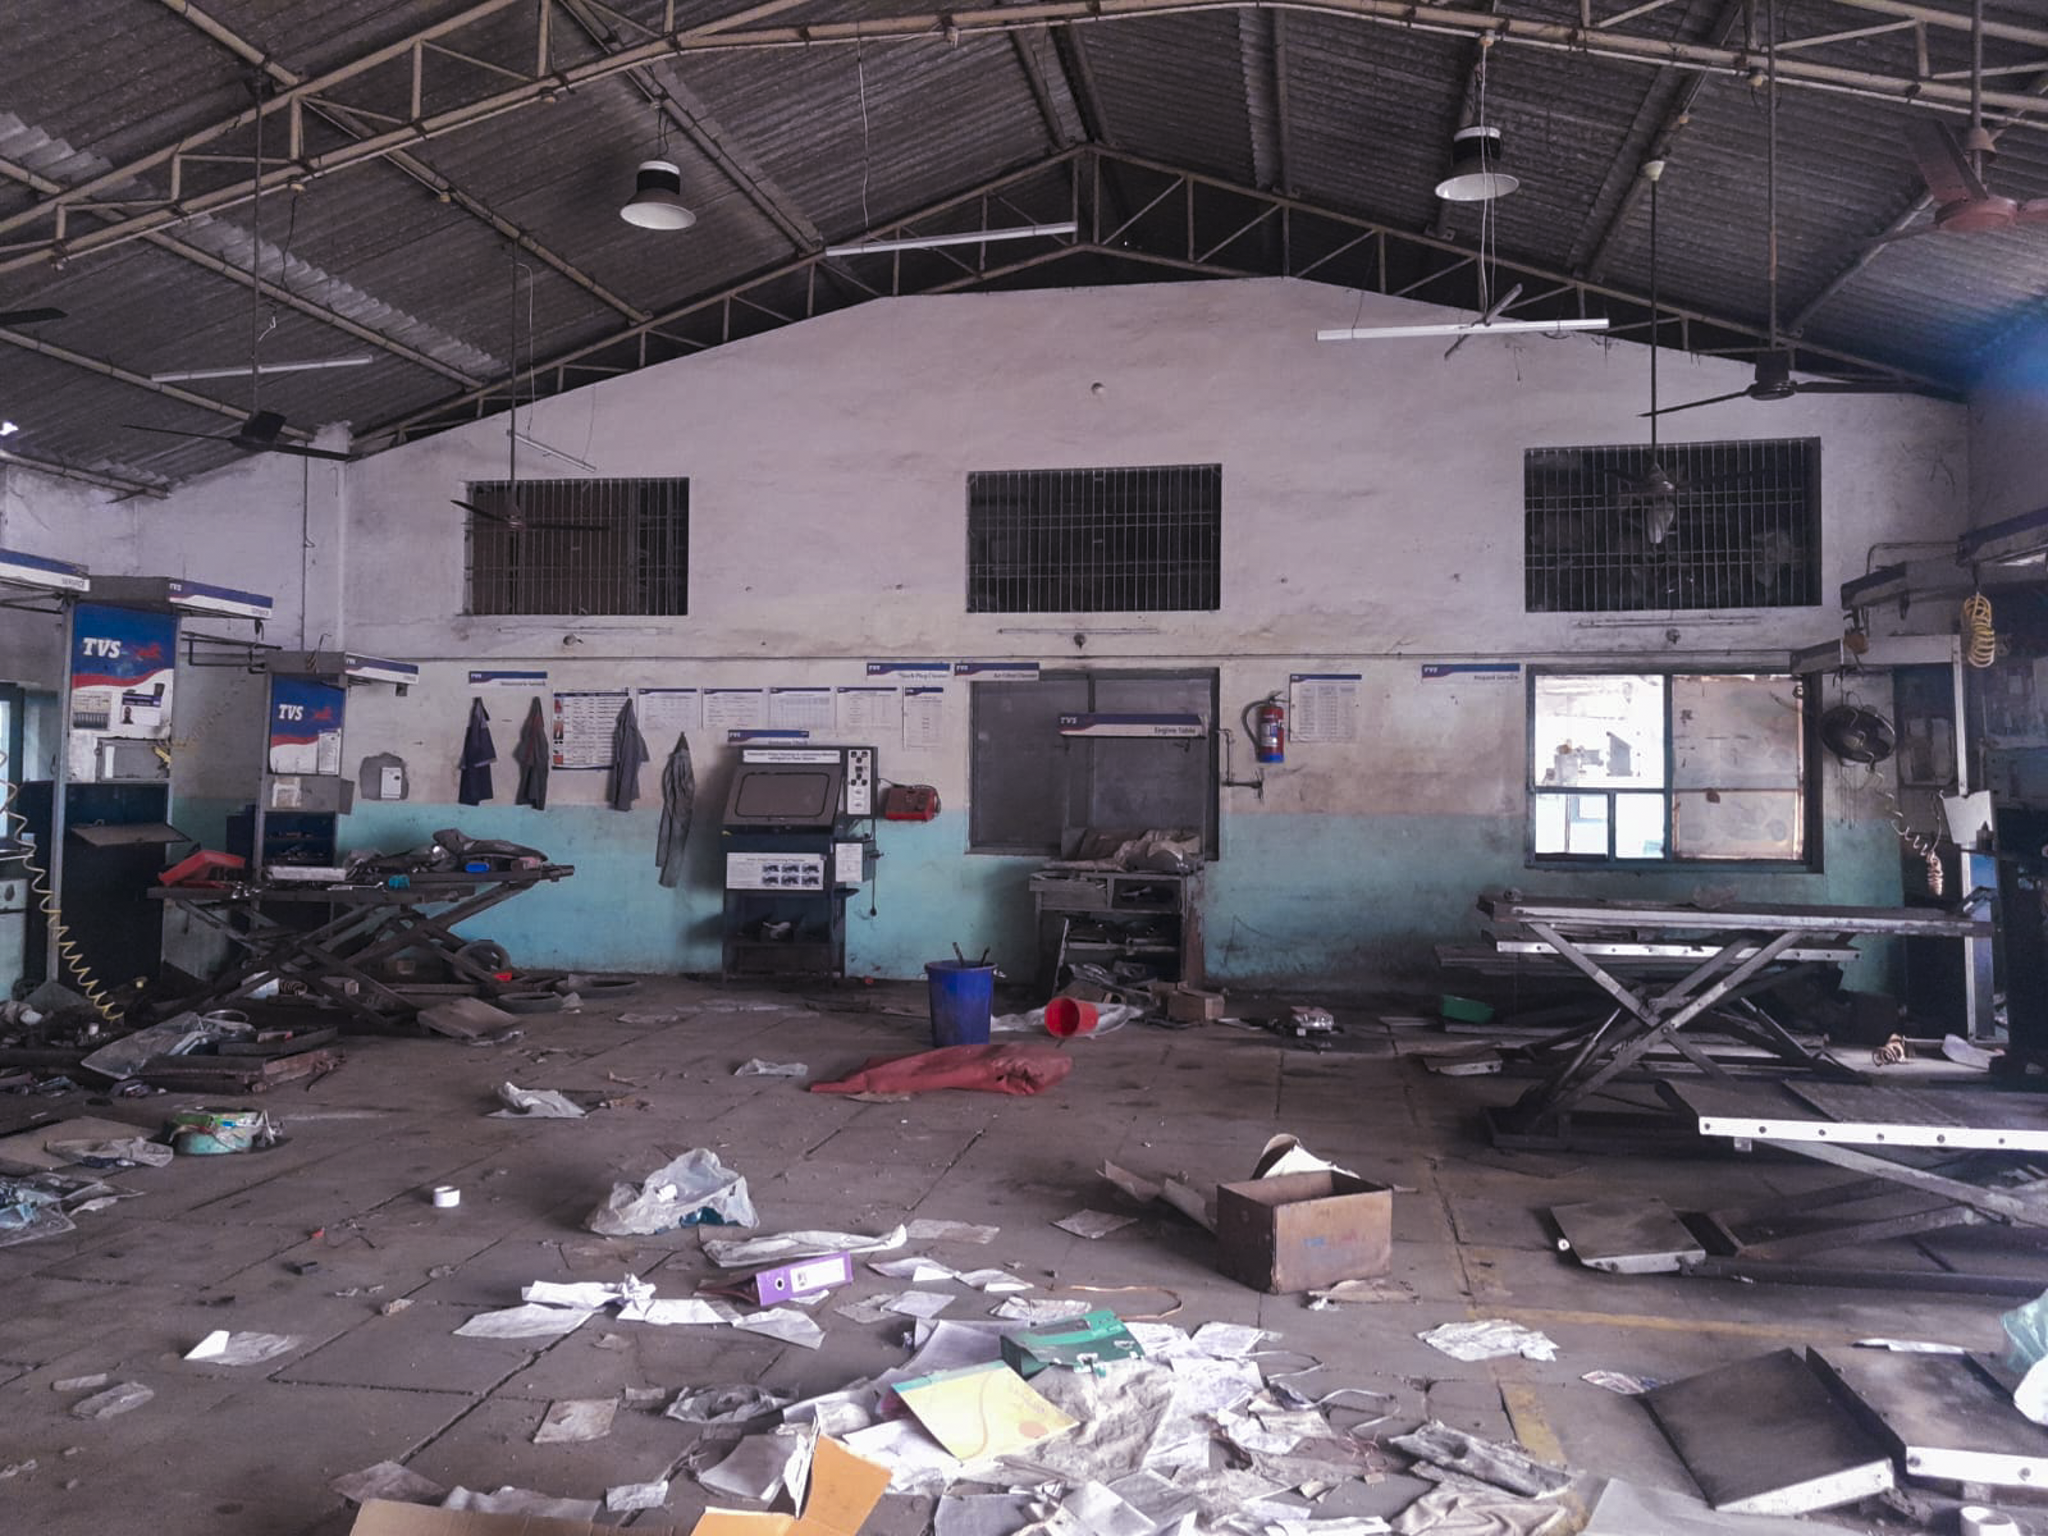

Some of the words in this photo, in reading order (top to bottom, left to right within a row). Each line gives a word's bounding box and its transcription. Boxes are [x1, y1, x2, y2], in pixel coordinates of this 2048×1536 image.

[83, 637, 121, 659] TVS
[279, 704, 304, 721] TVS
[1060, 716, 1077, 724] TVS
